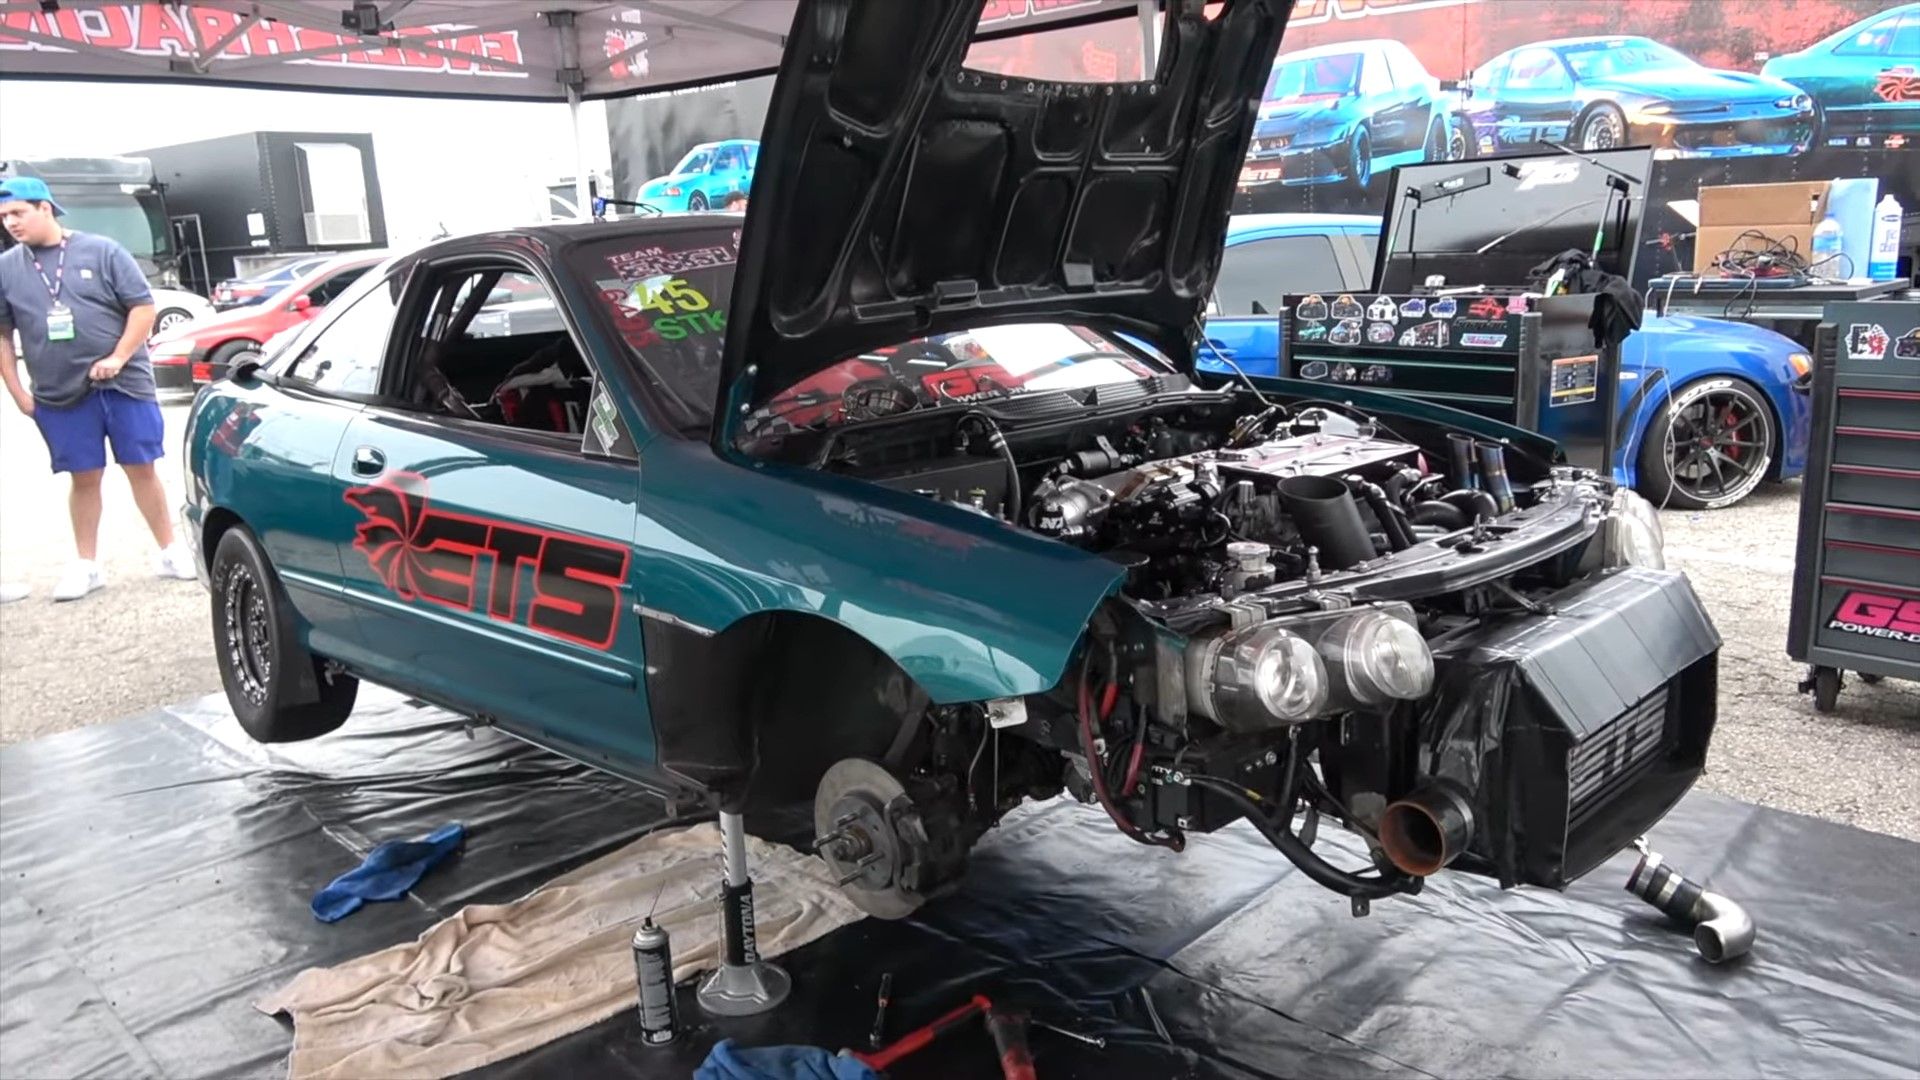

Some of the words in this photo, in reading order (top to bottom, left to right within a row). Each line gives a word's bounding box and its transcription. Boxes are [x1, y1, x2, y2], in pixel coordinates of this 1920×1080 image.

[606, 247, 662, 264] TEAM
[634, 279, 710, 314] 45
[1668, 379, 1733, 416] TOYO
[390, 500, 632, 651] ETS
[740, 893, 756, 963] DAYTONA
